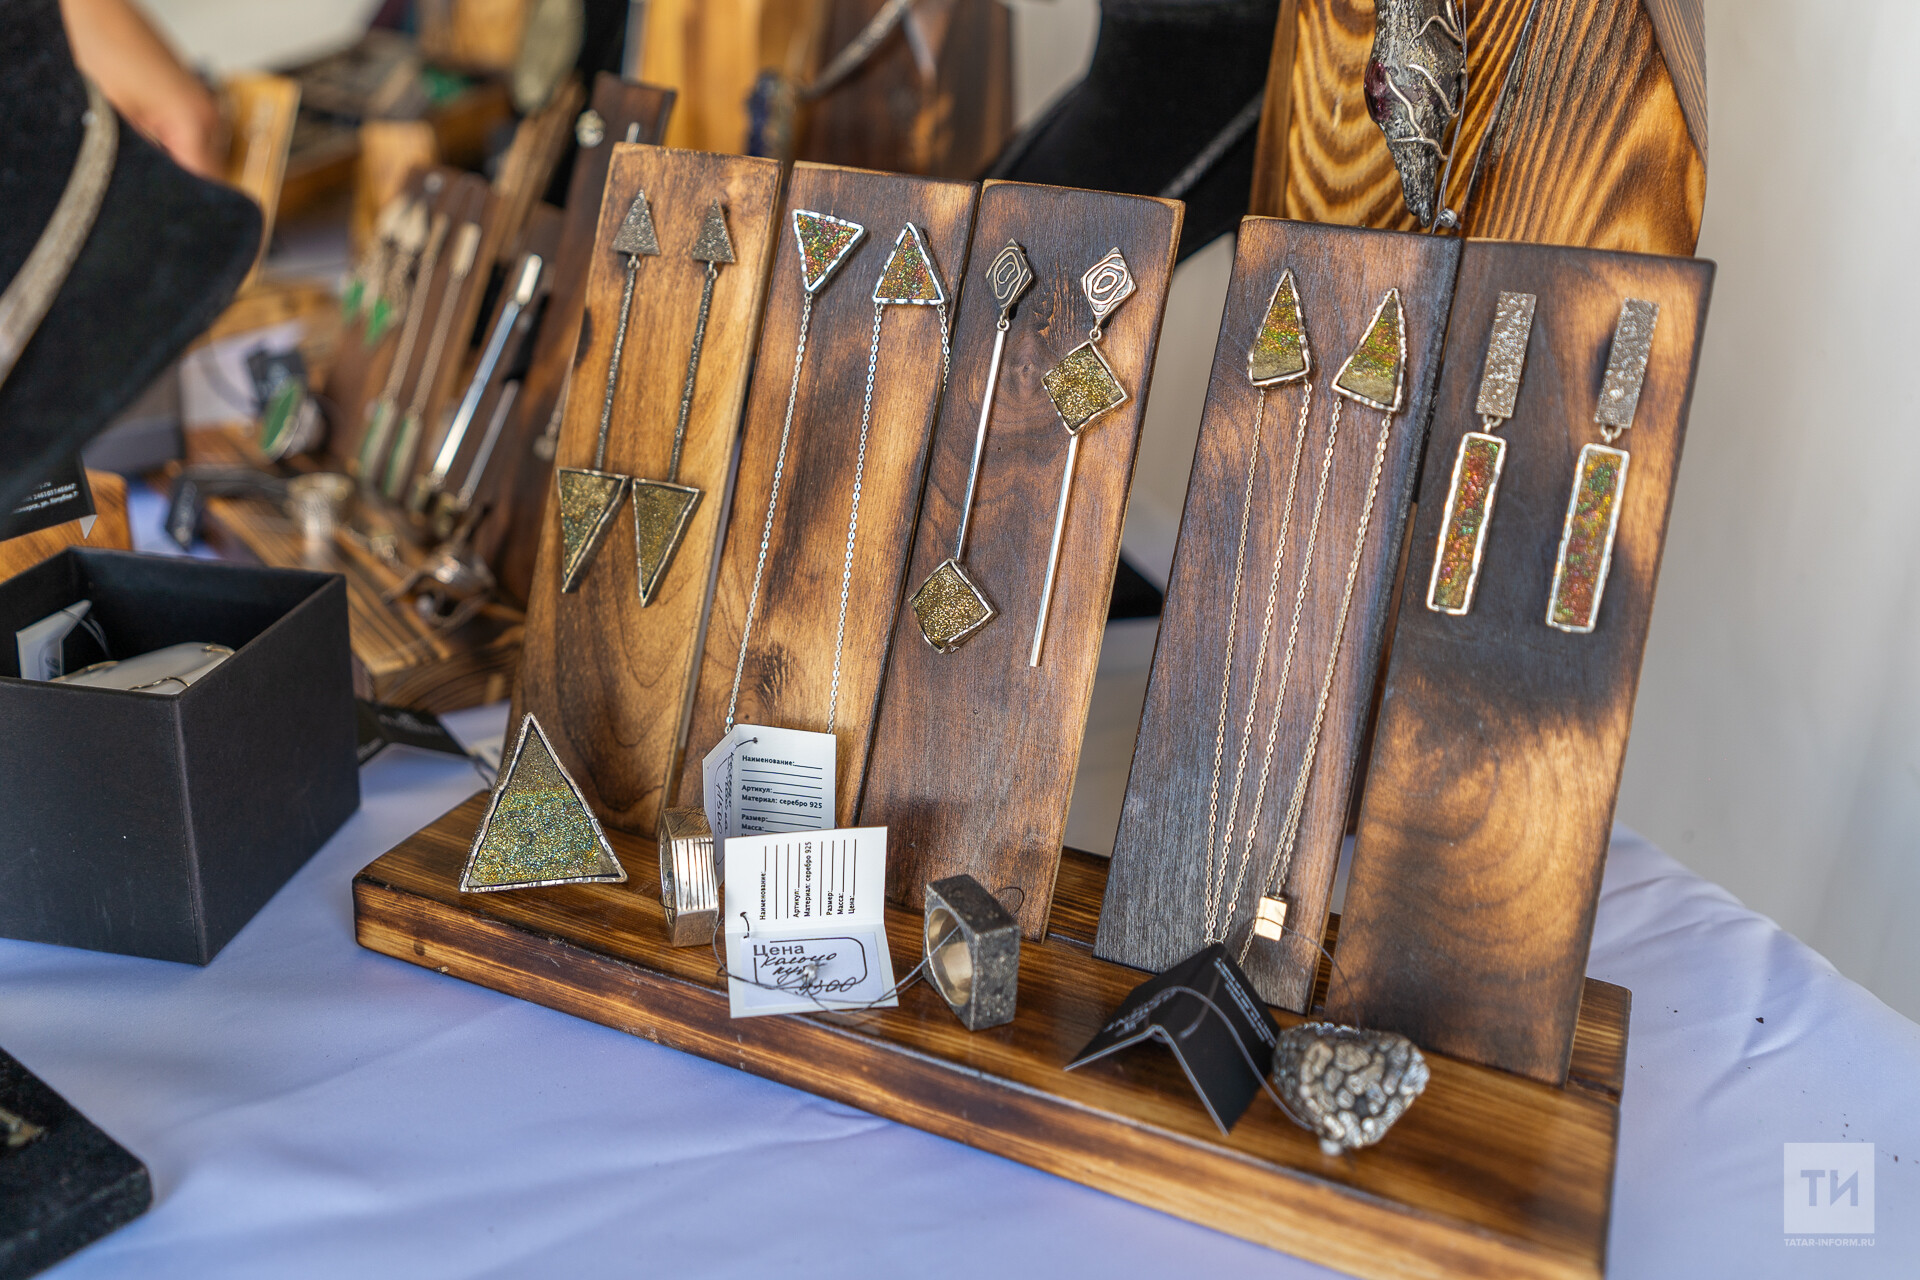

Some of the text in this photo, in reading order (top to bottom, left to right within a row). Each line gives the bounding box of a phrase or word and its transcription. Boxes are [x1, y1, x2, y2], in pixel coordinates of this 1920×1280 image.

[742, 755, 795, 766] Наименование:
[741, 785, 773, 794] Артикул:
[741, 794, 777, 804] Материал:
[779, 798, 808, 808] серебро
[741, 814, 768, 823] Размер:
[741, 823, 765, 831] Масса:
[804, 841, 812, 854] 925
[759, 871, 767, 920] Наименование:
[803, 883, 811, 917] Материал:
[825, 890, 833, 916] Размер:
[753, 944, 805, 957] Цена
